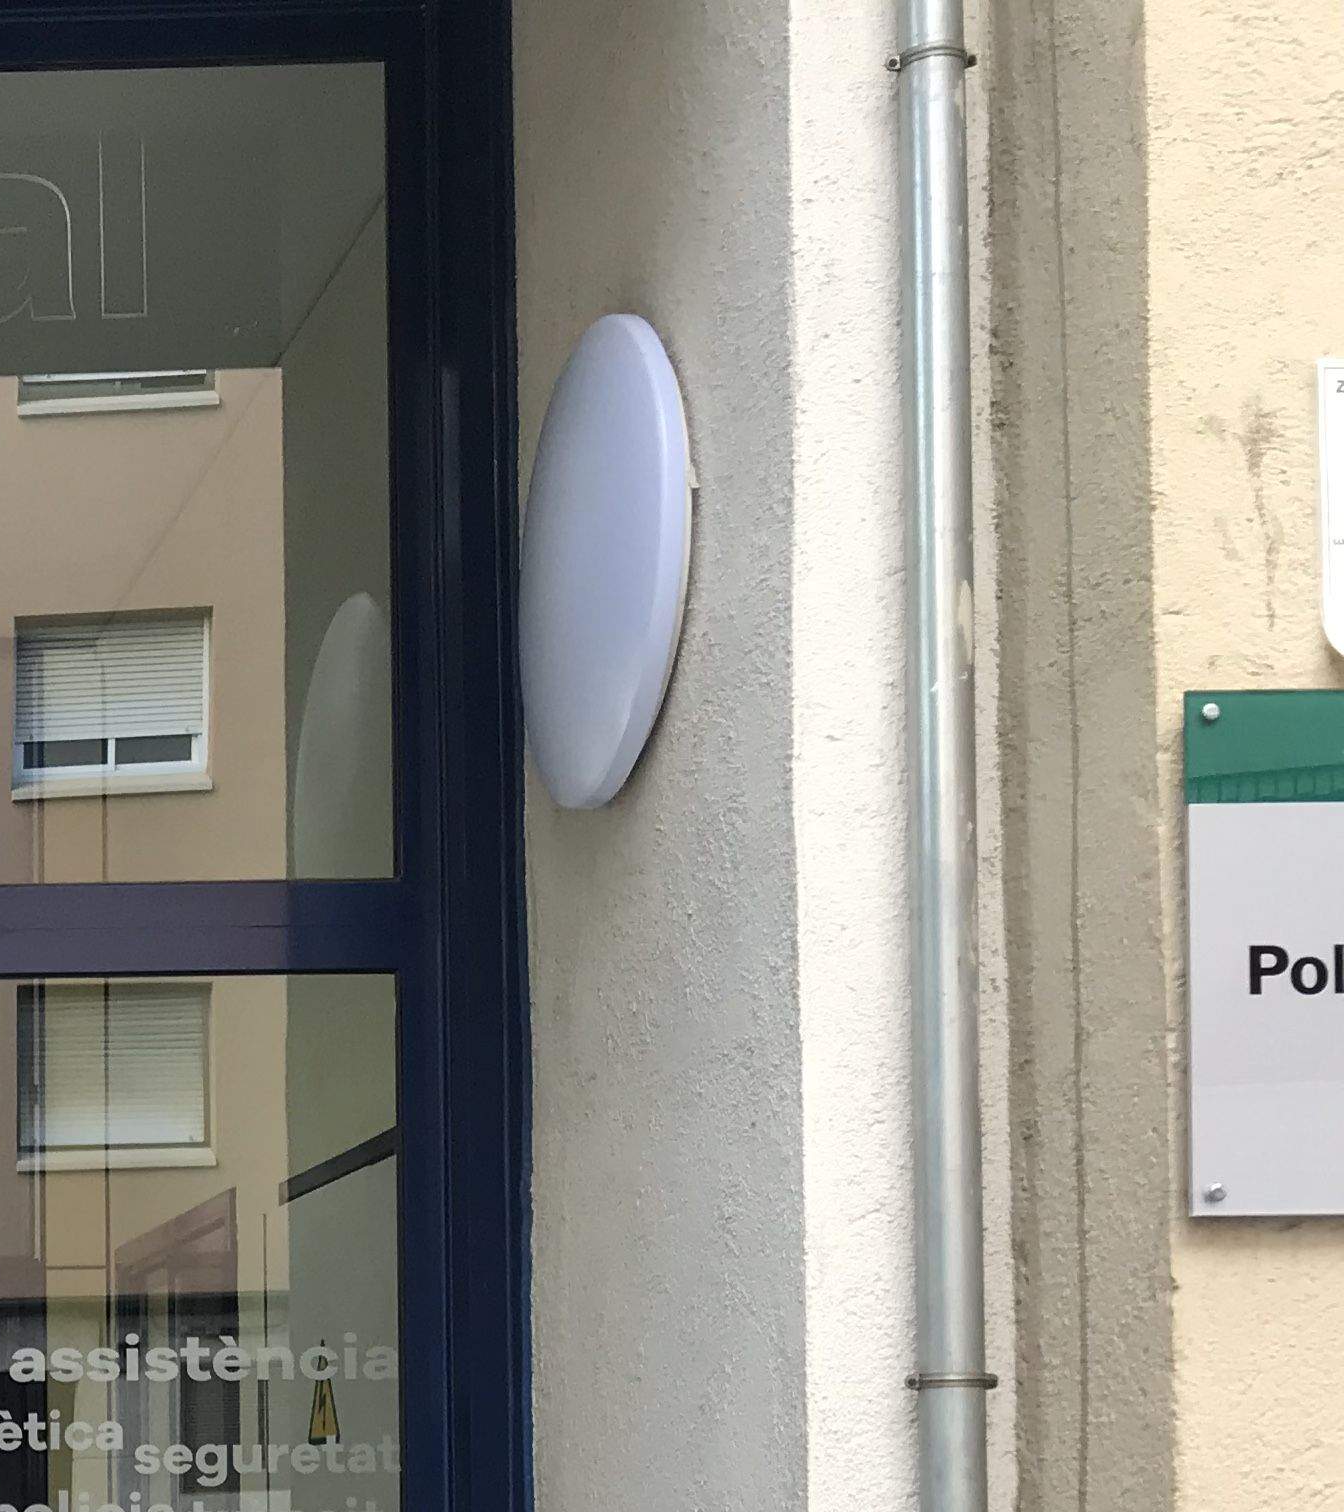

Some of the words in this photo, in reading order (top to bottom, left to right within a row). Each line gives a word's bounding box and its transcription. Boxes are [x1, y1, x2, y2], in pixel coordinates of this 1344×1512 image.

[1249, 944, 1344, 996] Pol
[9, 1333, 399, 1382] assistència
[134, 1434, 401, 1486] seguretat
